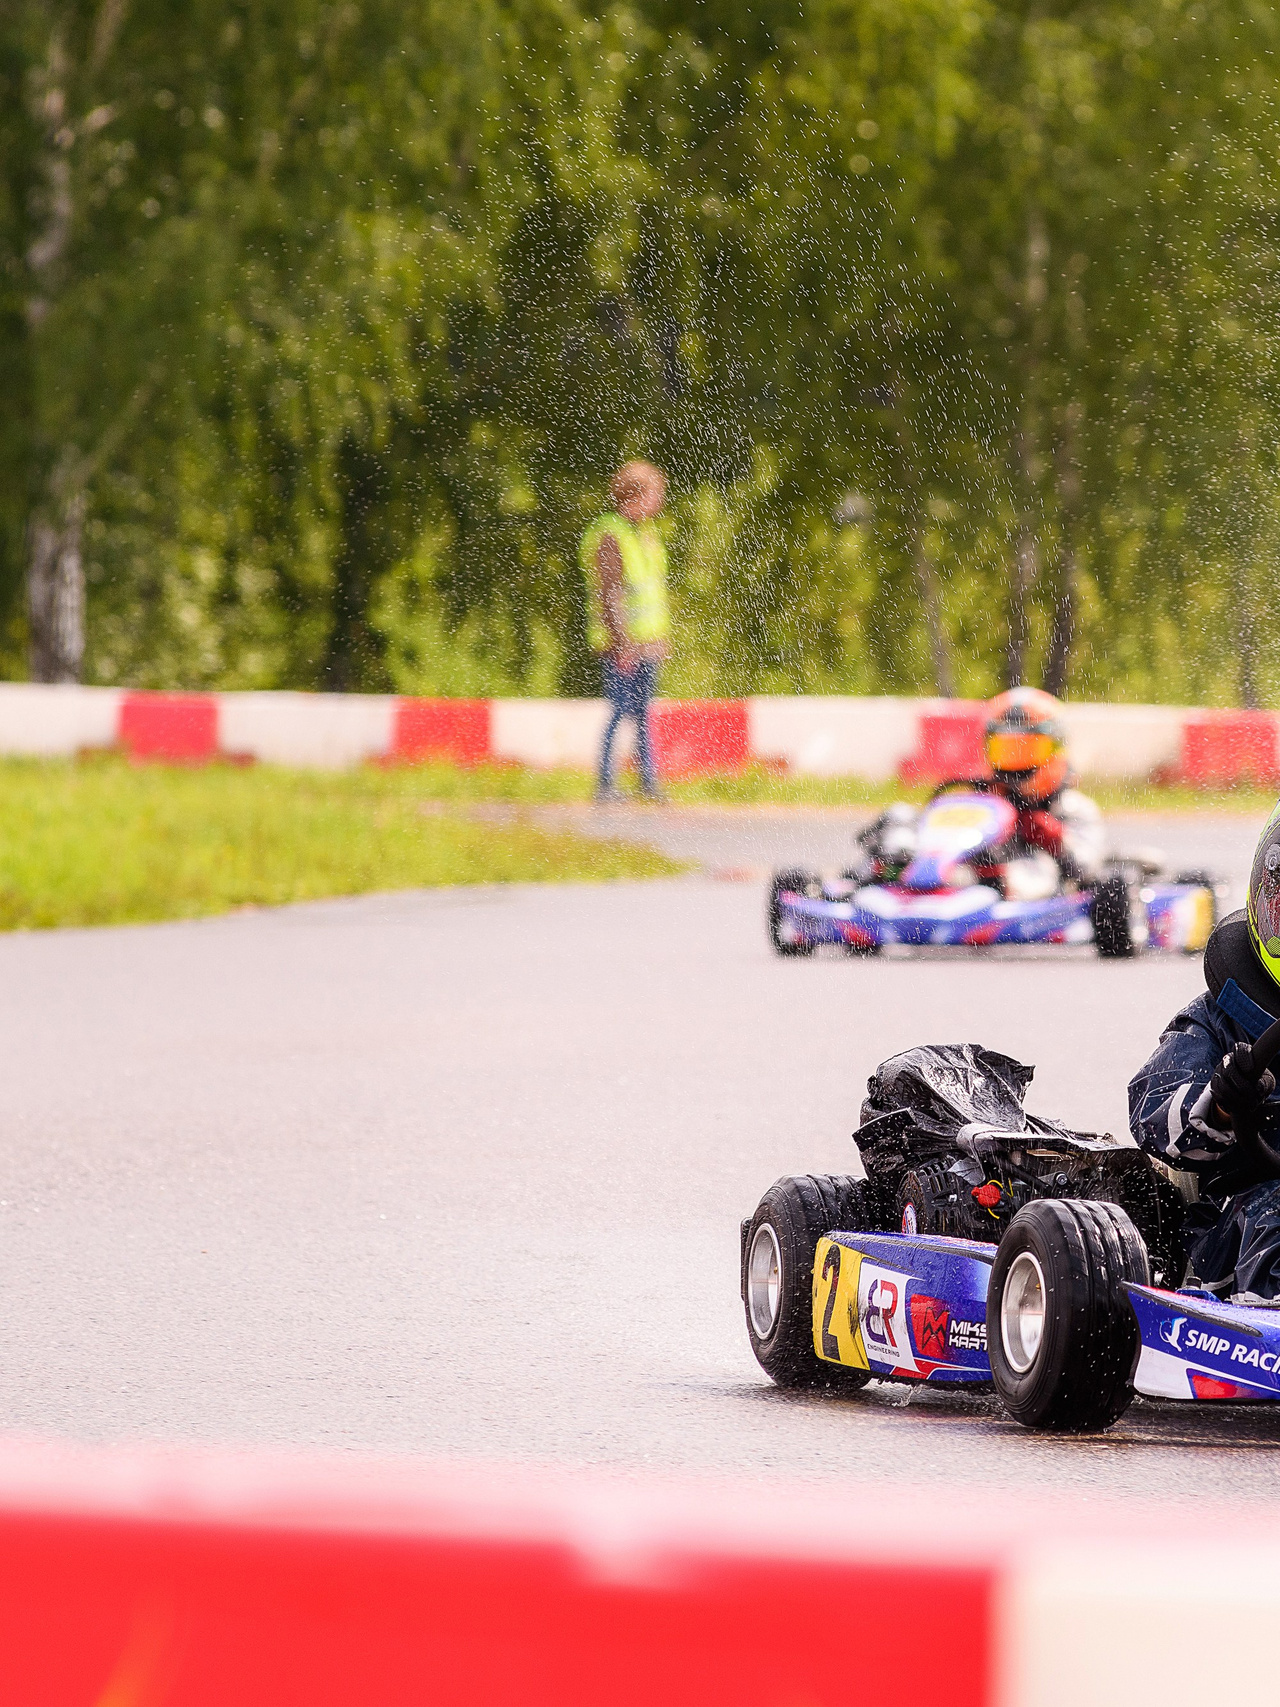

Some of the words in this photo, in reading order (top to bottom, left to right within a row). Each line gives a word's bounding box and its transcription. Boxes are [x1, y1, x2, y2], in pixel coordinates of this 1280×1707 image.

[821, 1244, 841, 1361] 2
[867, 1343, 900, 1358] ENGINEERING
[1184, 1329, 1231, 1356] SMP
